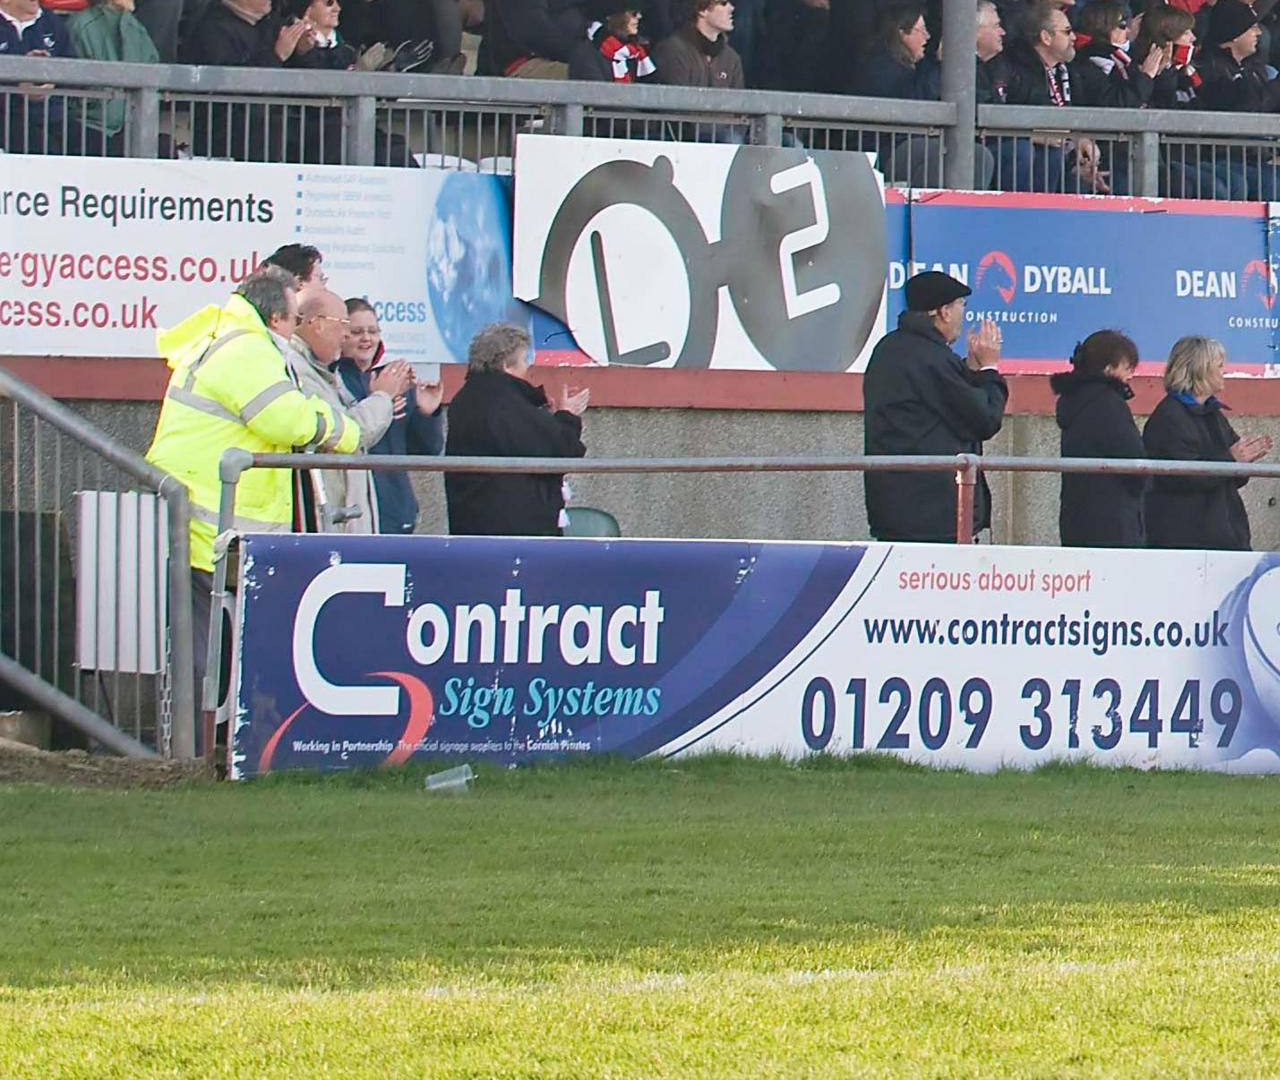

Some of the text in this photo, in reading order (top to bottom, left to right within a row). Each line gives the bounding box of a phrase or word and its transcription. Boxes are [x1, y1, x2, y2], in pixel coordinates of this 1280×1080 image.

[0, 184, 274, 227] rce Requirements
[0, 250, 262, 288] egyaccess.co.uk
[1024, 265, 1112, 295] DYBALL
[1175, 270, 1236, 299] DEAN
[366, 297, 426, 323] ccess
[965, 310, 1058, 324] ONSTRUCTION
[898, 564, 1092, 599] serious about sport
[292, 562, 665, 716] Contract
[864, 610, 1230, 656] www.contractsigns.co.uk
[439, 677, 661, 729] Sign Systems
[800, 676, 1244, 751] 01209 313449
[292, 740, 330, 754] Working
[332, 741, 341, 751] in
[342, 741, 394, 753] Partnership
[527, 740, 560, 751] Cornish
